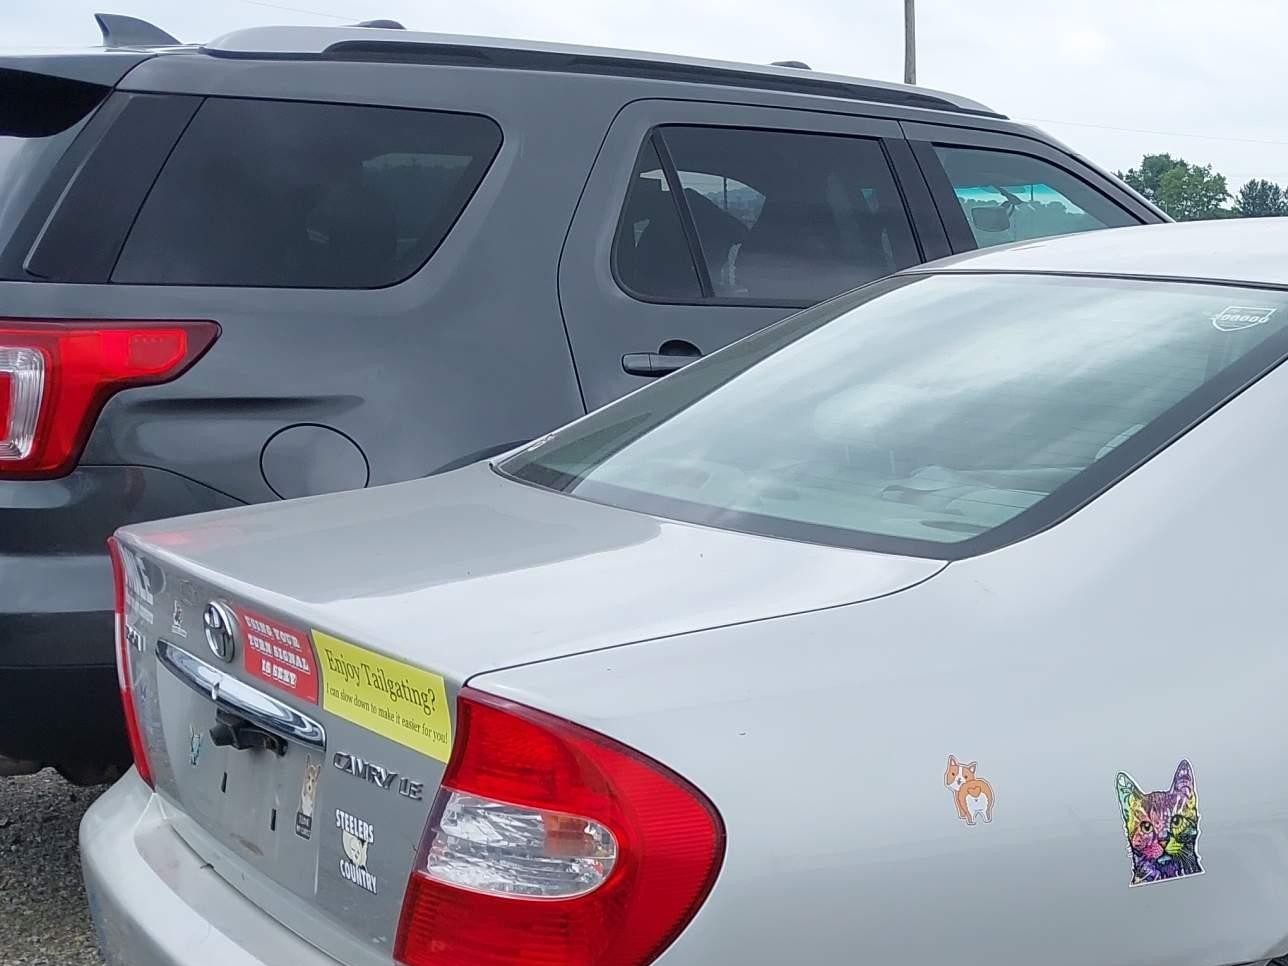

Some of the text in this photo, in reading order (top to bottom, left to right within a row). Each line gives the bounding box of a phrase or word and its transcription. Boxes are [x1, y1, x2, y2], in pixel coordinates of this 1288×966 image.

[247, 634, 310, 673] TURN SIGNAL
[271, 627, 301, 649] YOUR
[271, 665, 297, 686] SEXY
[324, 648, 437, 716] Enjoy Tailgating?
[353, 693, 371, 712] down
[377, 707, 396, 722] make
[401, 717, 421, 733] easier
[432, 730, 449, 746] you!
[333, 752, 398, 788] CAMRY
[335, 808, 374, 844] STEELERS
[339, 859, 377, 894] COUNTRY
